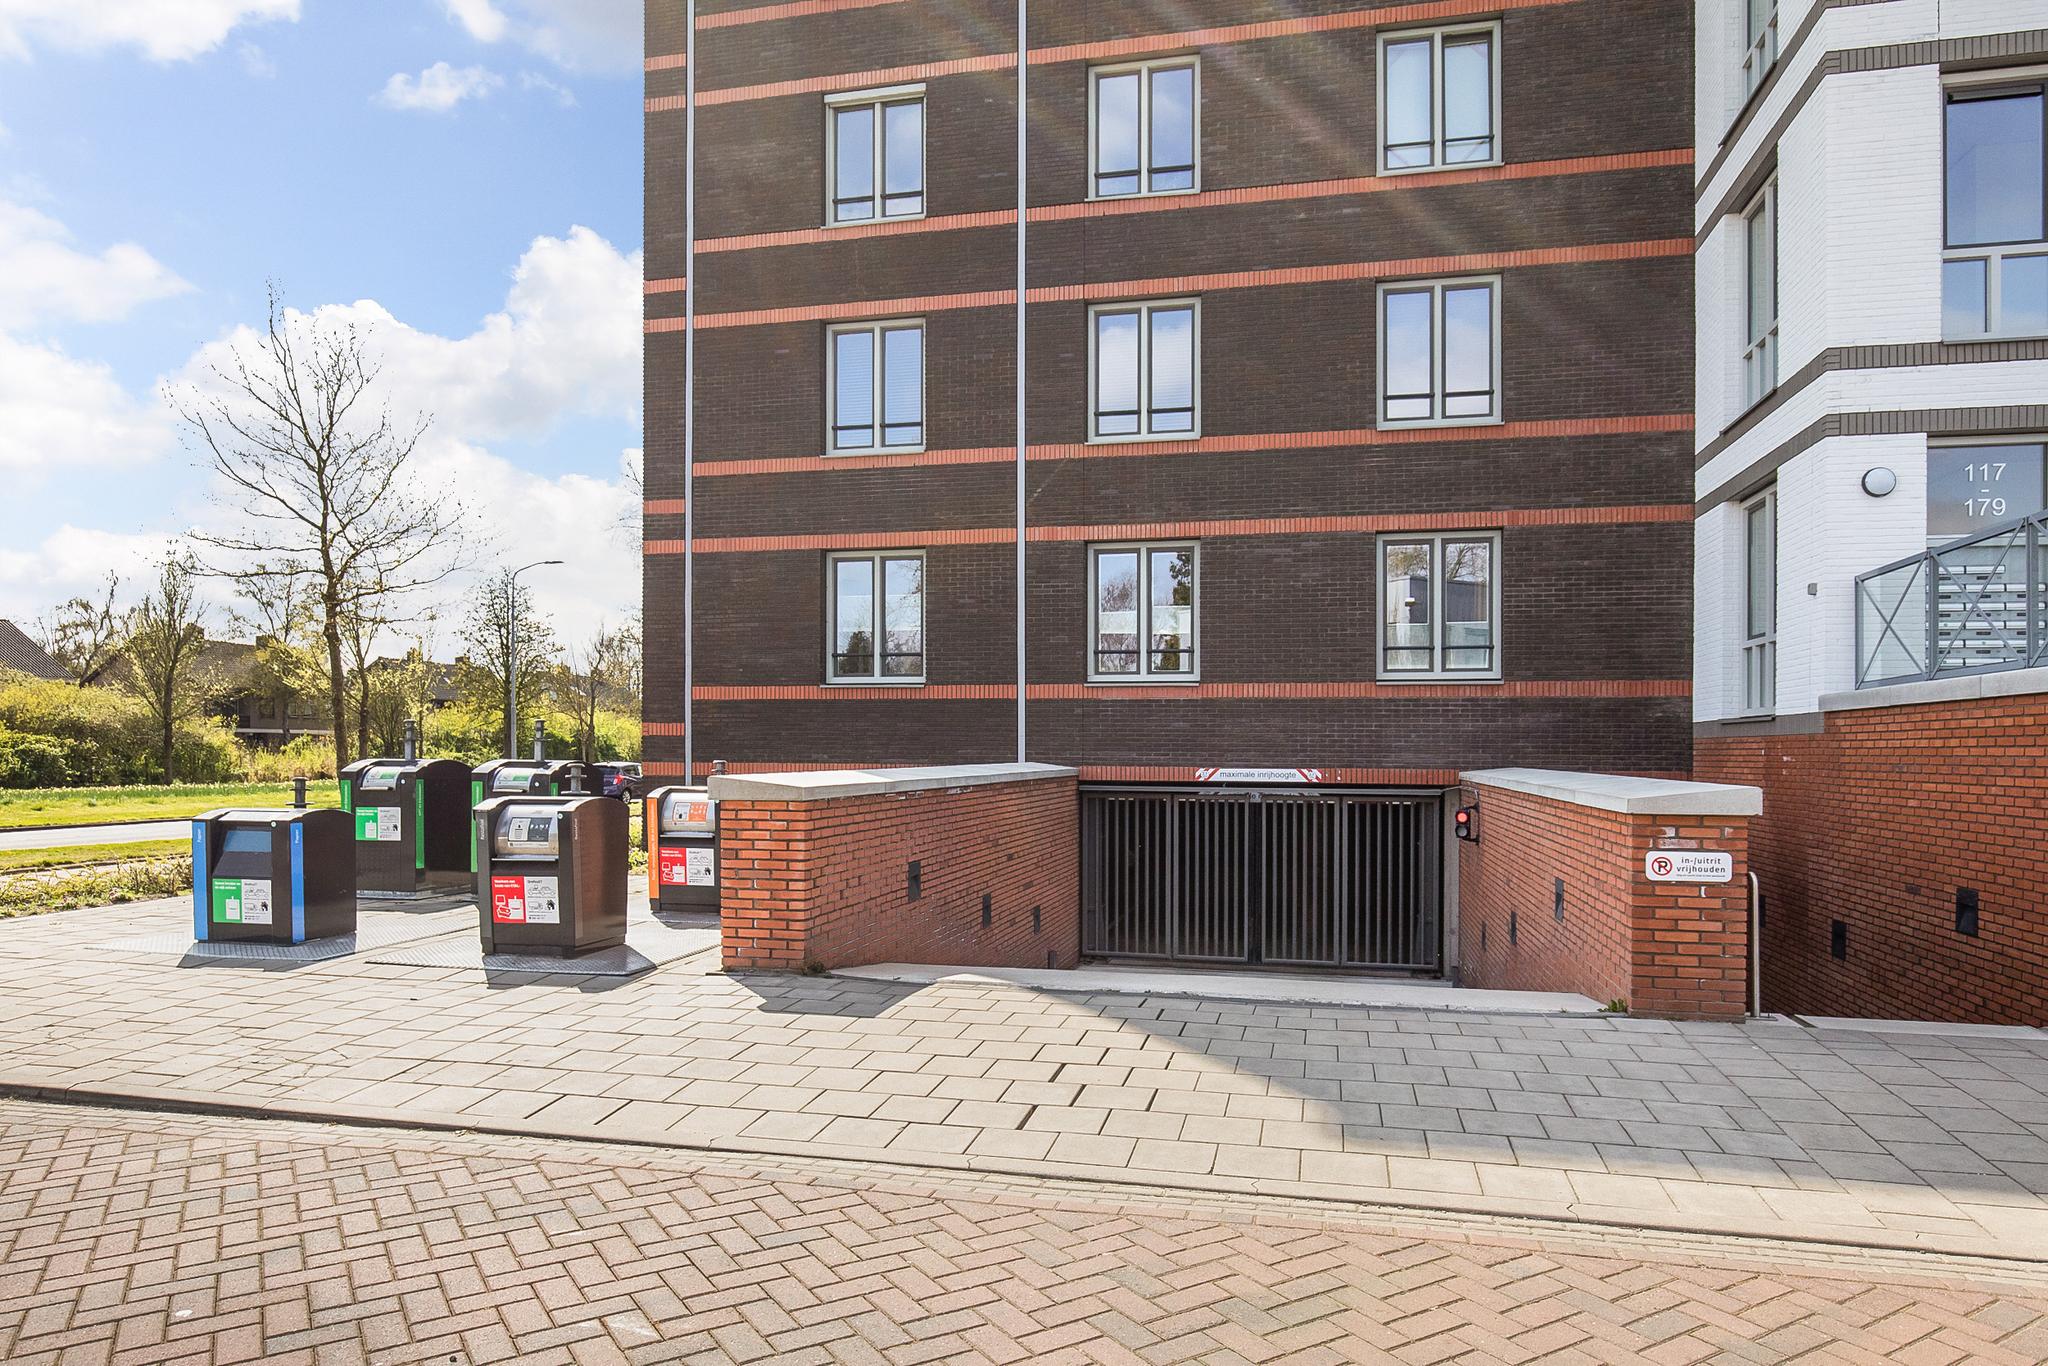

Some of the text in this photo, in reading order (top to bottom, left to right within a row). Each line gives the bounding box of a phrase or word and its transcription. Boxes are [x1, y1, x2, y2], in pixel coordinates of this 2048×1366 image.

[1963, 463, 2007, 482] 117
[1963, 497, 2006, 517] 179
[1219, 770, 1255, 778] maximale
[1257, 770, 1297, 780] inrijhoogte
[1681, 857, 1721, 865] in-/uitrit
[1676, 865, 1726, 874] vrijhouden
